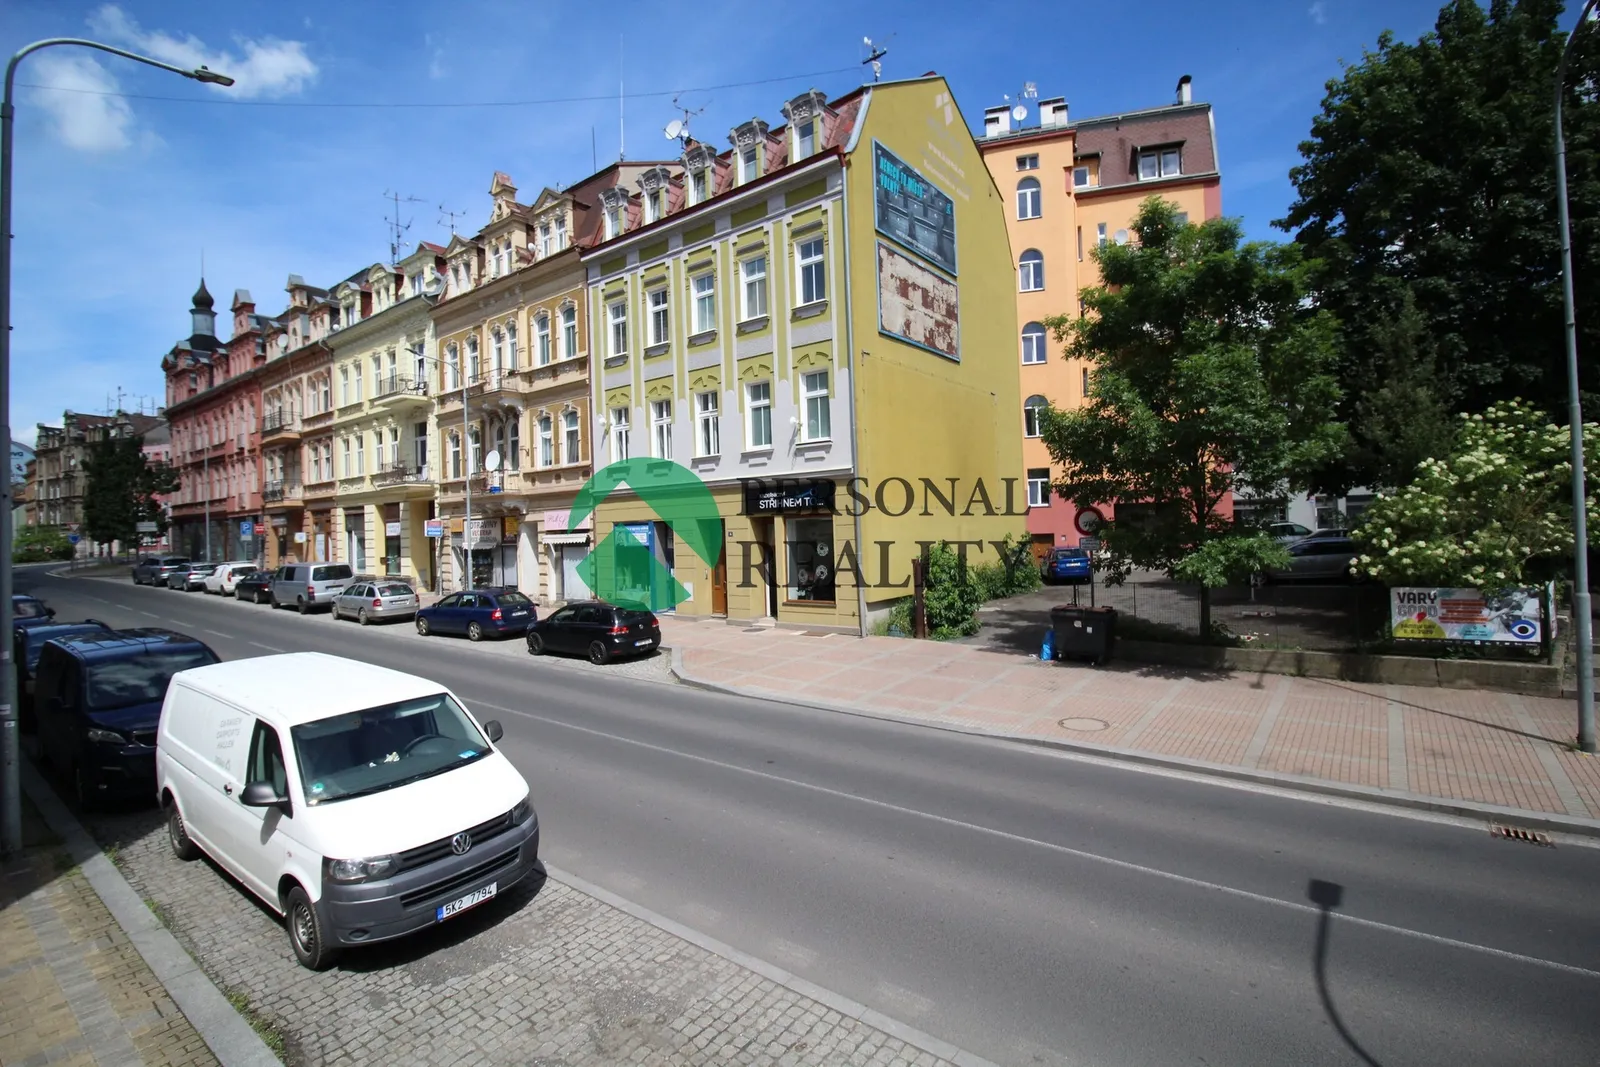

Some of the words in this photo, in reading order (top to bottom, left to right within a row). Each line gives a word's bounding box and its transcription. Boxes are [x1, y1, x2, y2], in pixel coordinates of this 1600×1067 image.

[1397, 592, 1437, 604] VARY
[445, 900, 463, 914] 5K2
[471, 885, 492, 904] 7794
